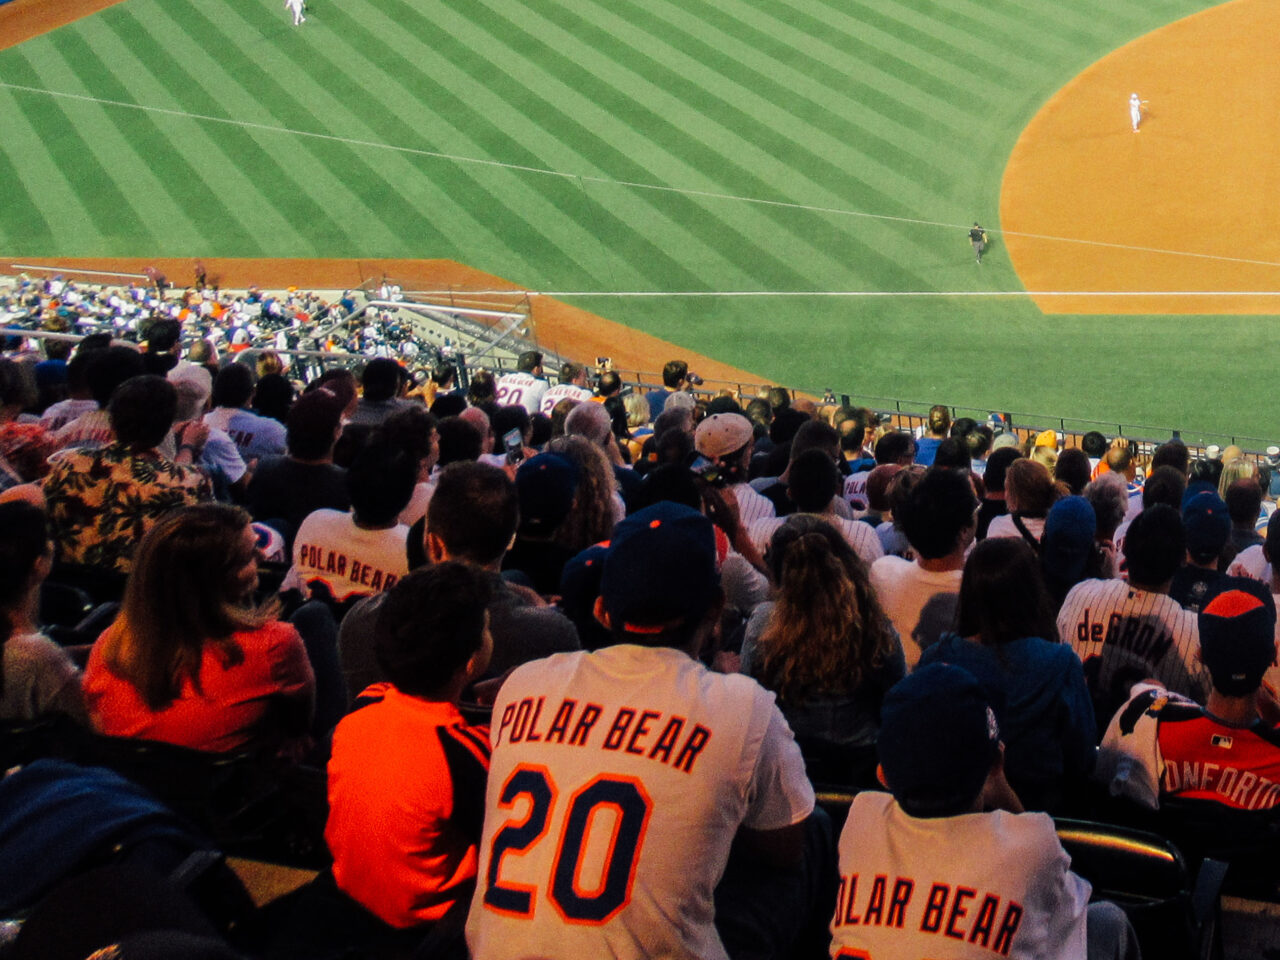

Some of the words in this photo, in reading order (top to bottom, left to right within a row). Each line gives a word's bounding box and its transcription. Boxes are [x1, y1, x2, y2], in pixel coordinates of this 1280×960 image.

[496, 386, 523, 405] 20
[300, 543, 347, 576] POLAR
[496, 696, 604, 747] POLAR
[601, 706, 713, 774] BEAR
[483, 762, 655, 927] 20
[834, 873, 915, 929] OLAR
[919, 881, 1024, 957] BEAR
